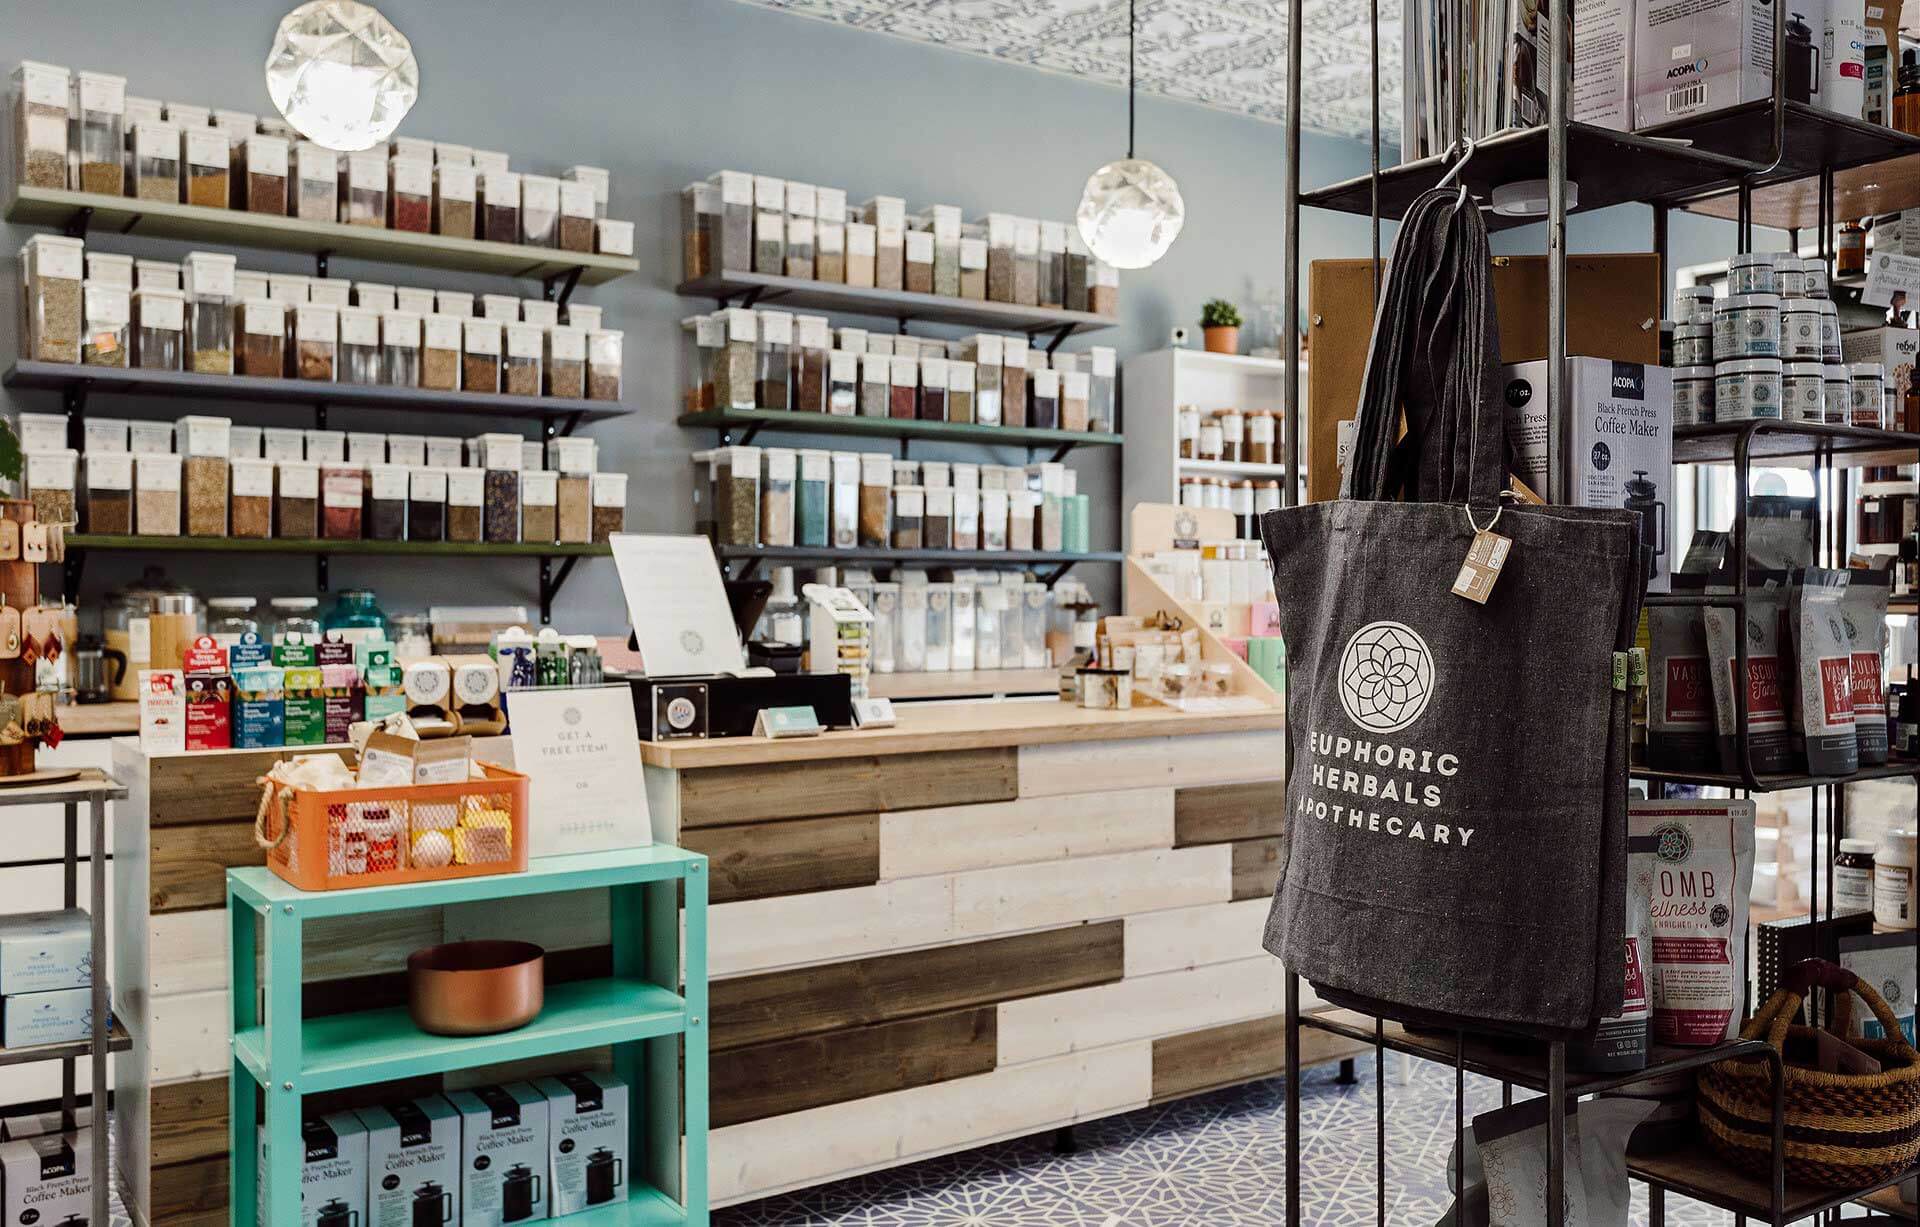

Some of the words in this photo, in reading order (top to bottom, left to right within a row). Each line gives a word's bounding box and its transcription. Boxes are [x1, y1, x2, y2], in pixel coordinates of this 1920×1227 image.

[1666, 62, 1696, 80] ACOPA
[1613, 377, 1635, 389] ACOPA
[1524, 413, 1547, 425] Press
[1597, 402, 1616, 415] Black
[1617, 404, 1640, 417] French
[1640, 406, 1657, 418] Press
[1595, 416, 1627, 435] Coffee
[1629, 419, 1660, 438] Maker
[558, 731, 580, 741] GET
[584, 730, 592, 739] A
[542, 746, 572, 757] FREE
[576, 743, 609, 754] ITEM!
[1310, 731, 1459, 777] EUPHORIC
[1312, 763, 1442, 808] HERBALS
[1649, 896, 1707, 919] ellness
[561, 1123, 589, 1136] Coffee
[590, 1117, 617, 1131] Maker
[476, 1139, 505, 1153] Coffee
[507, 1133, 536, 1148] Maker
[42, 1165, 65, 1176] ACOPA
[384, 1159, 415, 1172] Coffee
[417, 1151, 447, 1166] Maker
[322, 1167, 353, 1181] Maker
[23, 1191, 57, 1205] Coffee
[60, 1184, 93, 1197] Maker
[26, 1185, 45, 1194] Black
